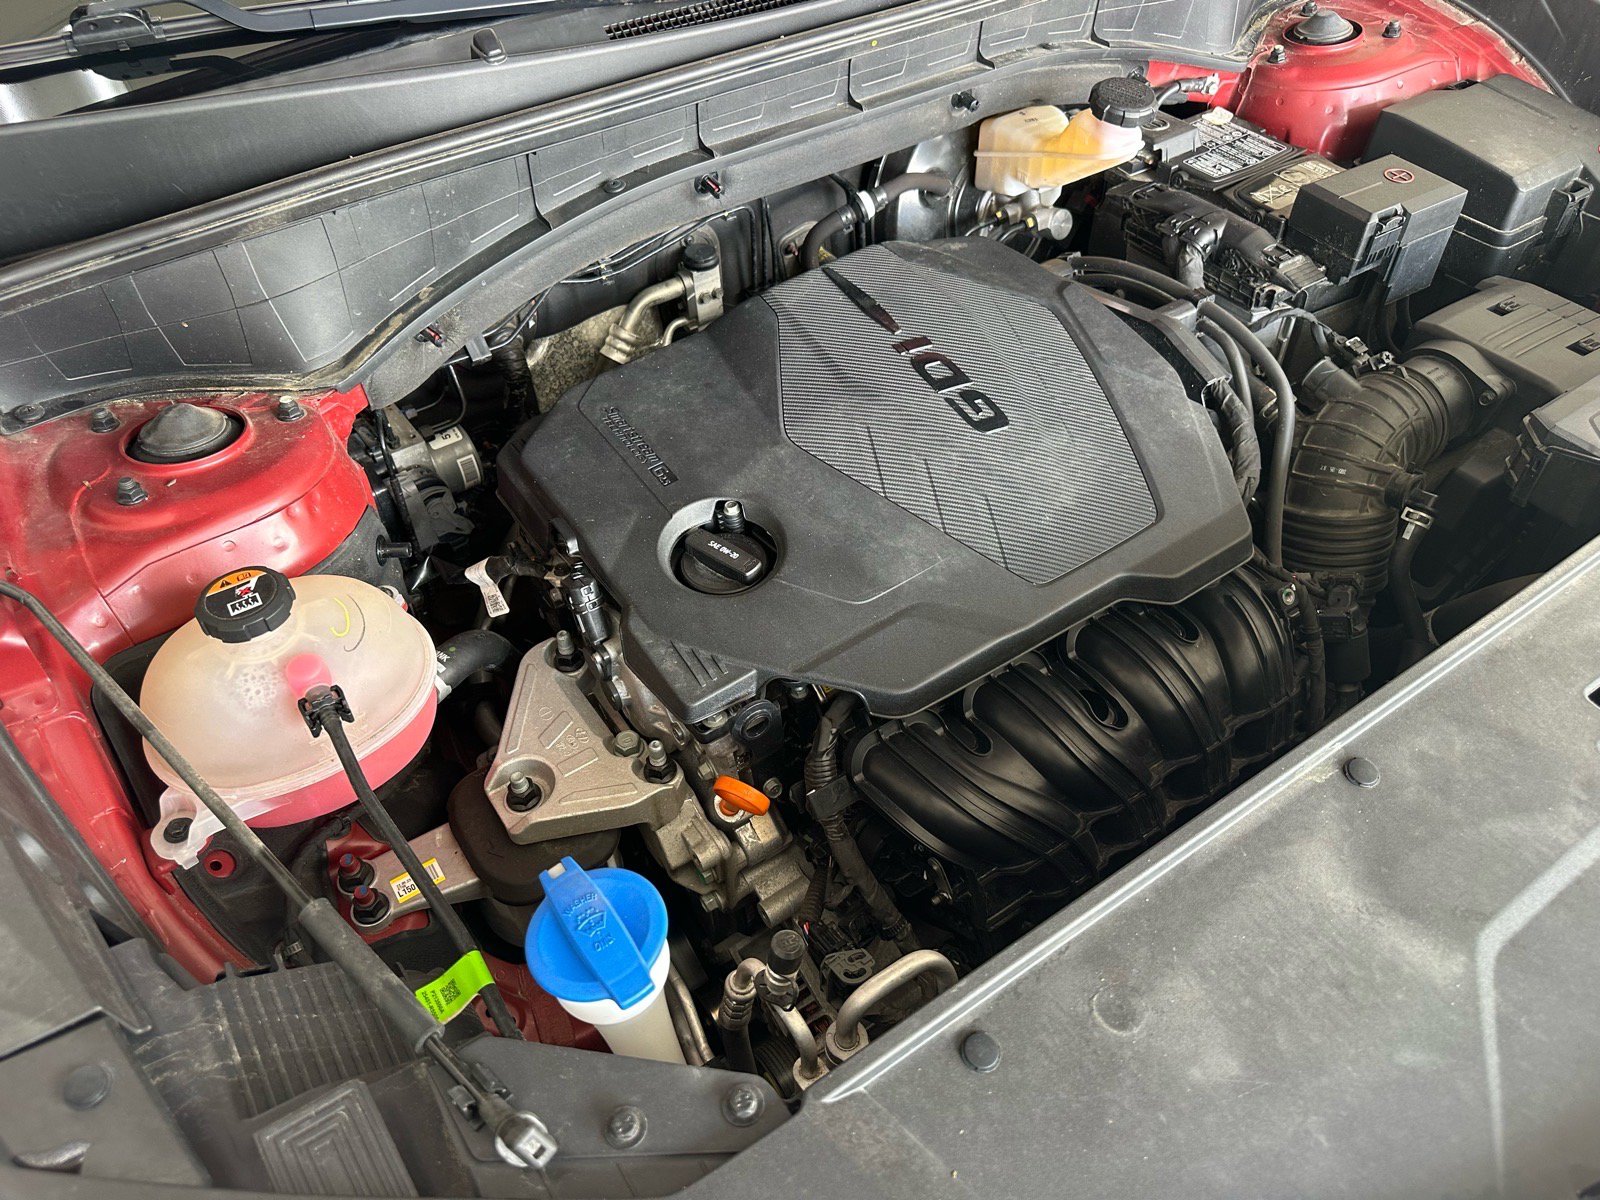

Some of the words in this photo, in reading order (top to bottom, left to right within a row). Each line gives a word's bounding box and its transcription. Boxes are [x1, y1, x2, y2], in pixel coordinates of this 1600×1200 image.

[602, 415, 647, 464] TECHNOLOGY
[604, 406, 660, 463] Smartstream
[707, 540, 722, 550] SAE
[719, 546, 740, 560] 0W-20
[397, 883, 416, 898] L150
[562, 893, 598, 917] WASHER
